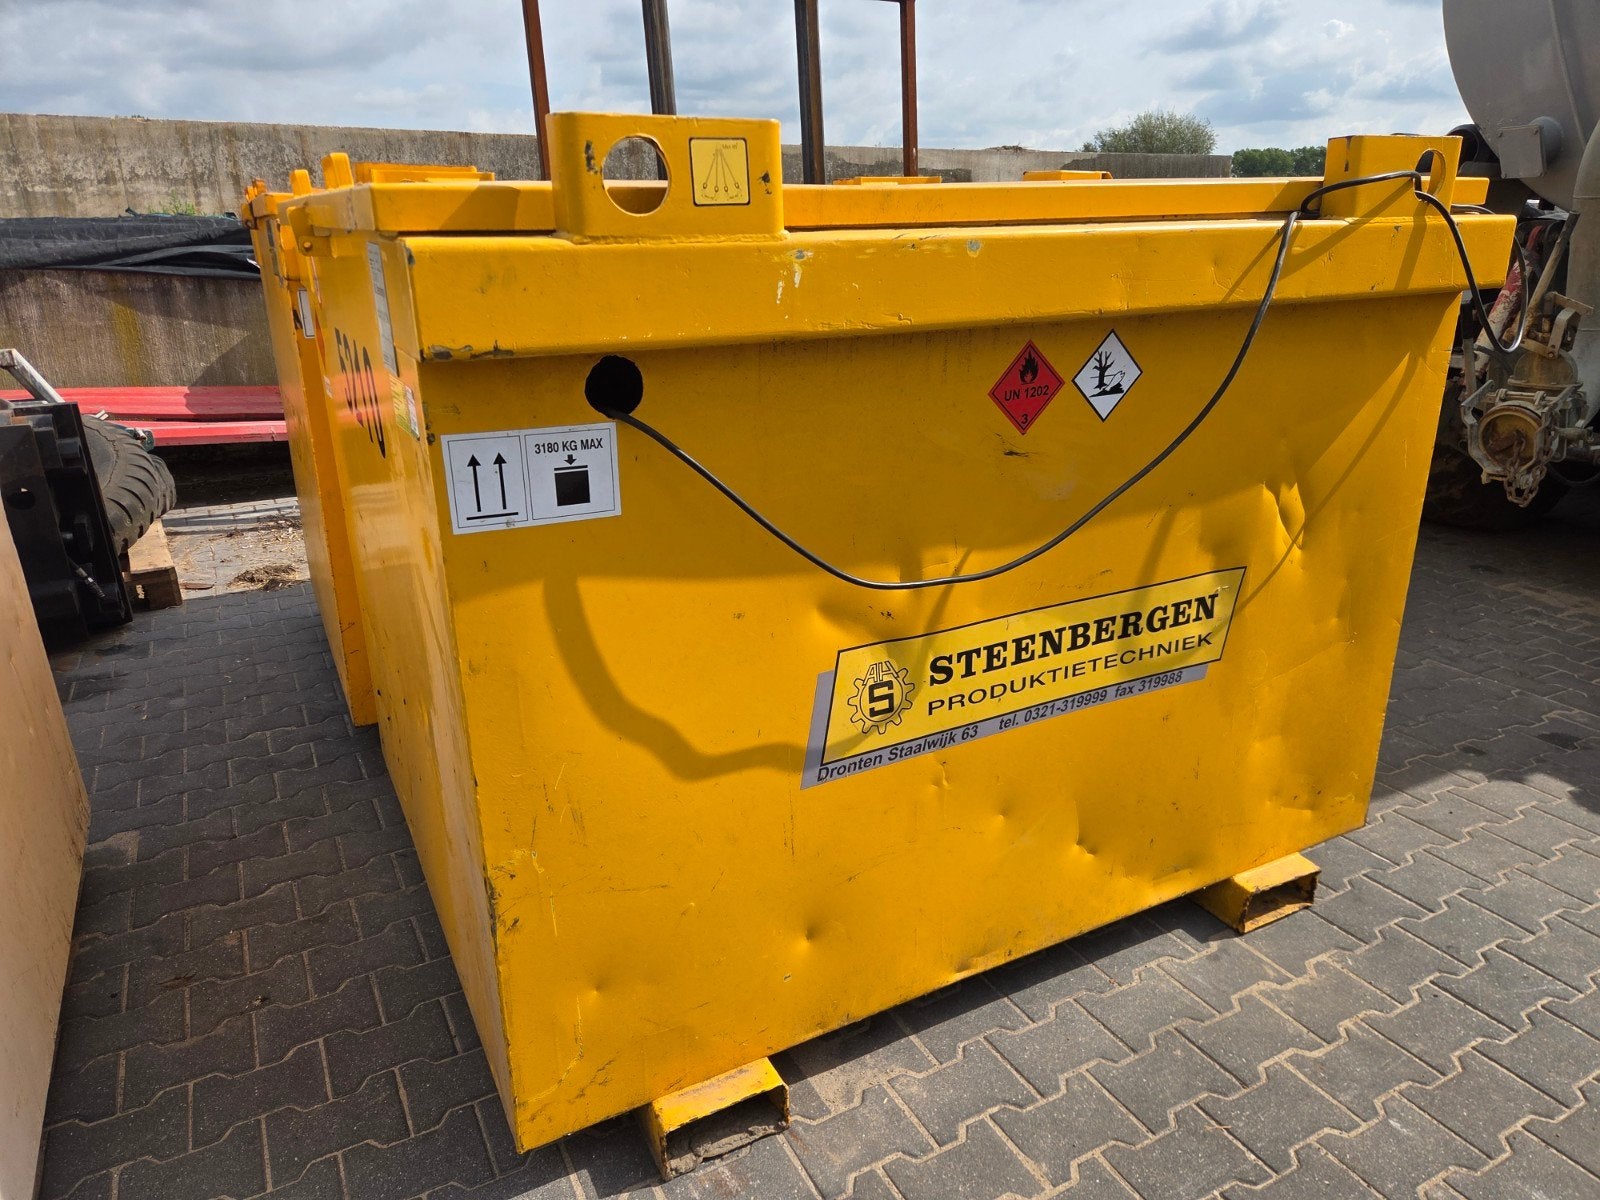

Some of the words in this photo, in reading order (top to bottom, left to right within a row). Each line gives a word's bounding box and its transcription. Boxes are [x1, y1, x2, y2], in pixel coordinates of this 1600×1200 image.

[1004, 389, 1020, 401] UN
[1025, 385, 1049, 399] 1202
[1021, 413, 1028, 424] 3
[534, 442, 559, 454] 3180
[562, 440, 578, 452] KG
[580, 438, 604, 450] MAX
[929, 593, 1219, 687] STEENBERGEN
[928, 632, 1213, 716] PRODUKTIETECHNIEK
[868, 679, 894, 718] S
[817, 753, 883, 782] Dronten
[887, 730, 957, 761] Staalwijk
[961, 725, 978, 741] 63
[999, 714, 1019, 730] tel.
[1024, 689, 1108, 723] 0321-319999
[1114, 685, 1135, 698] fax
[1138, 670, 1183, 693] 319988
